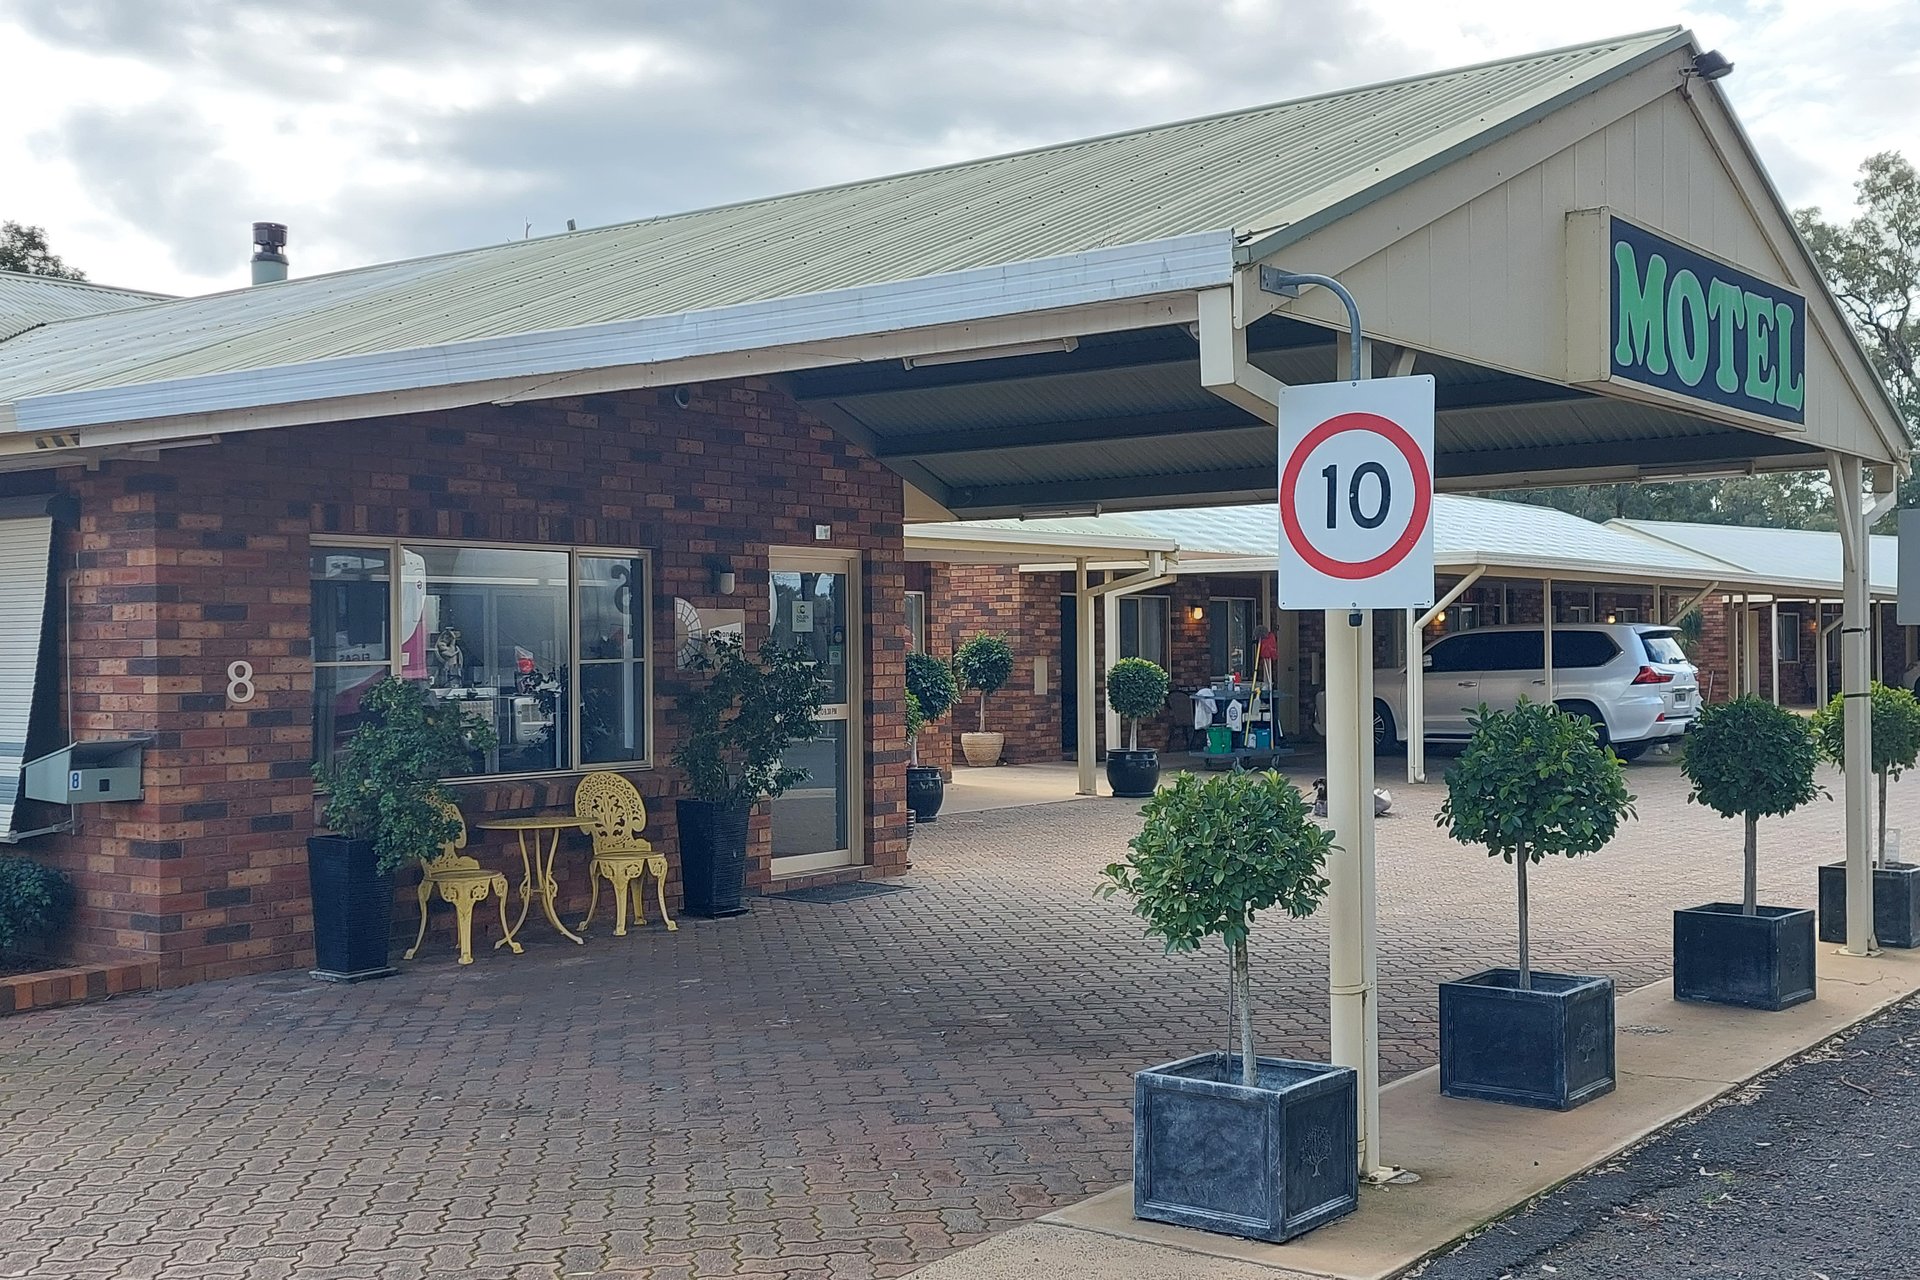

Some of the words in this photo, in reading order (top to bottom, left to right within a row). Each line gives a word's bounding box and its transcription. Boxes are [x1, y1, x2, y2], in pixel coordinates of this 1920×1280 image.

[1615, 241, 1804, 411] MOTEL
[1322, 461, 1391, 529] 10
[227, 660, 254, 702] 8
[72, 772, 79, 789] 8
